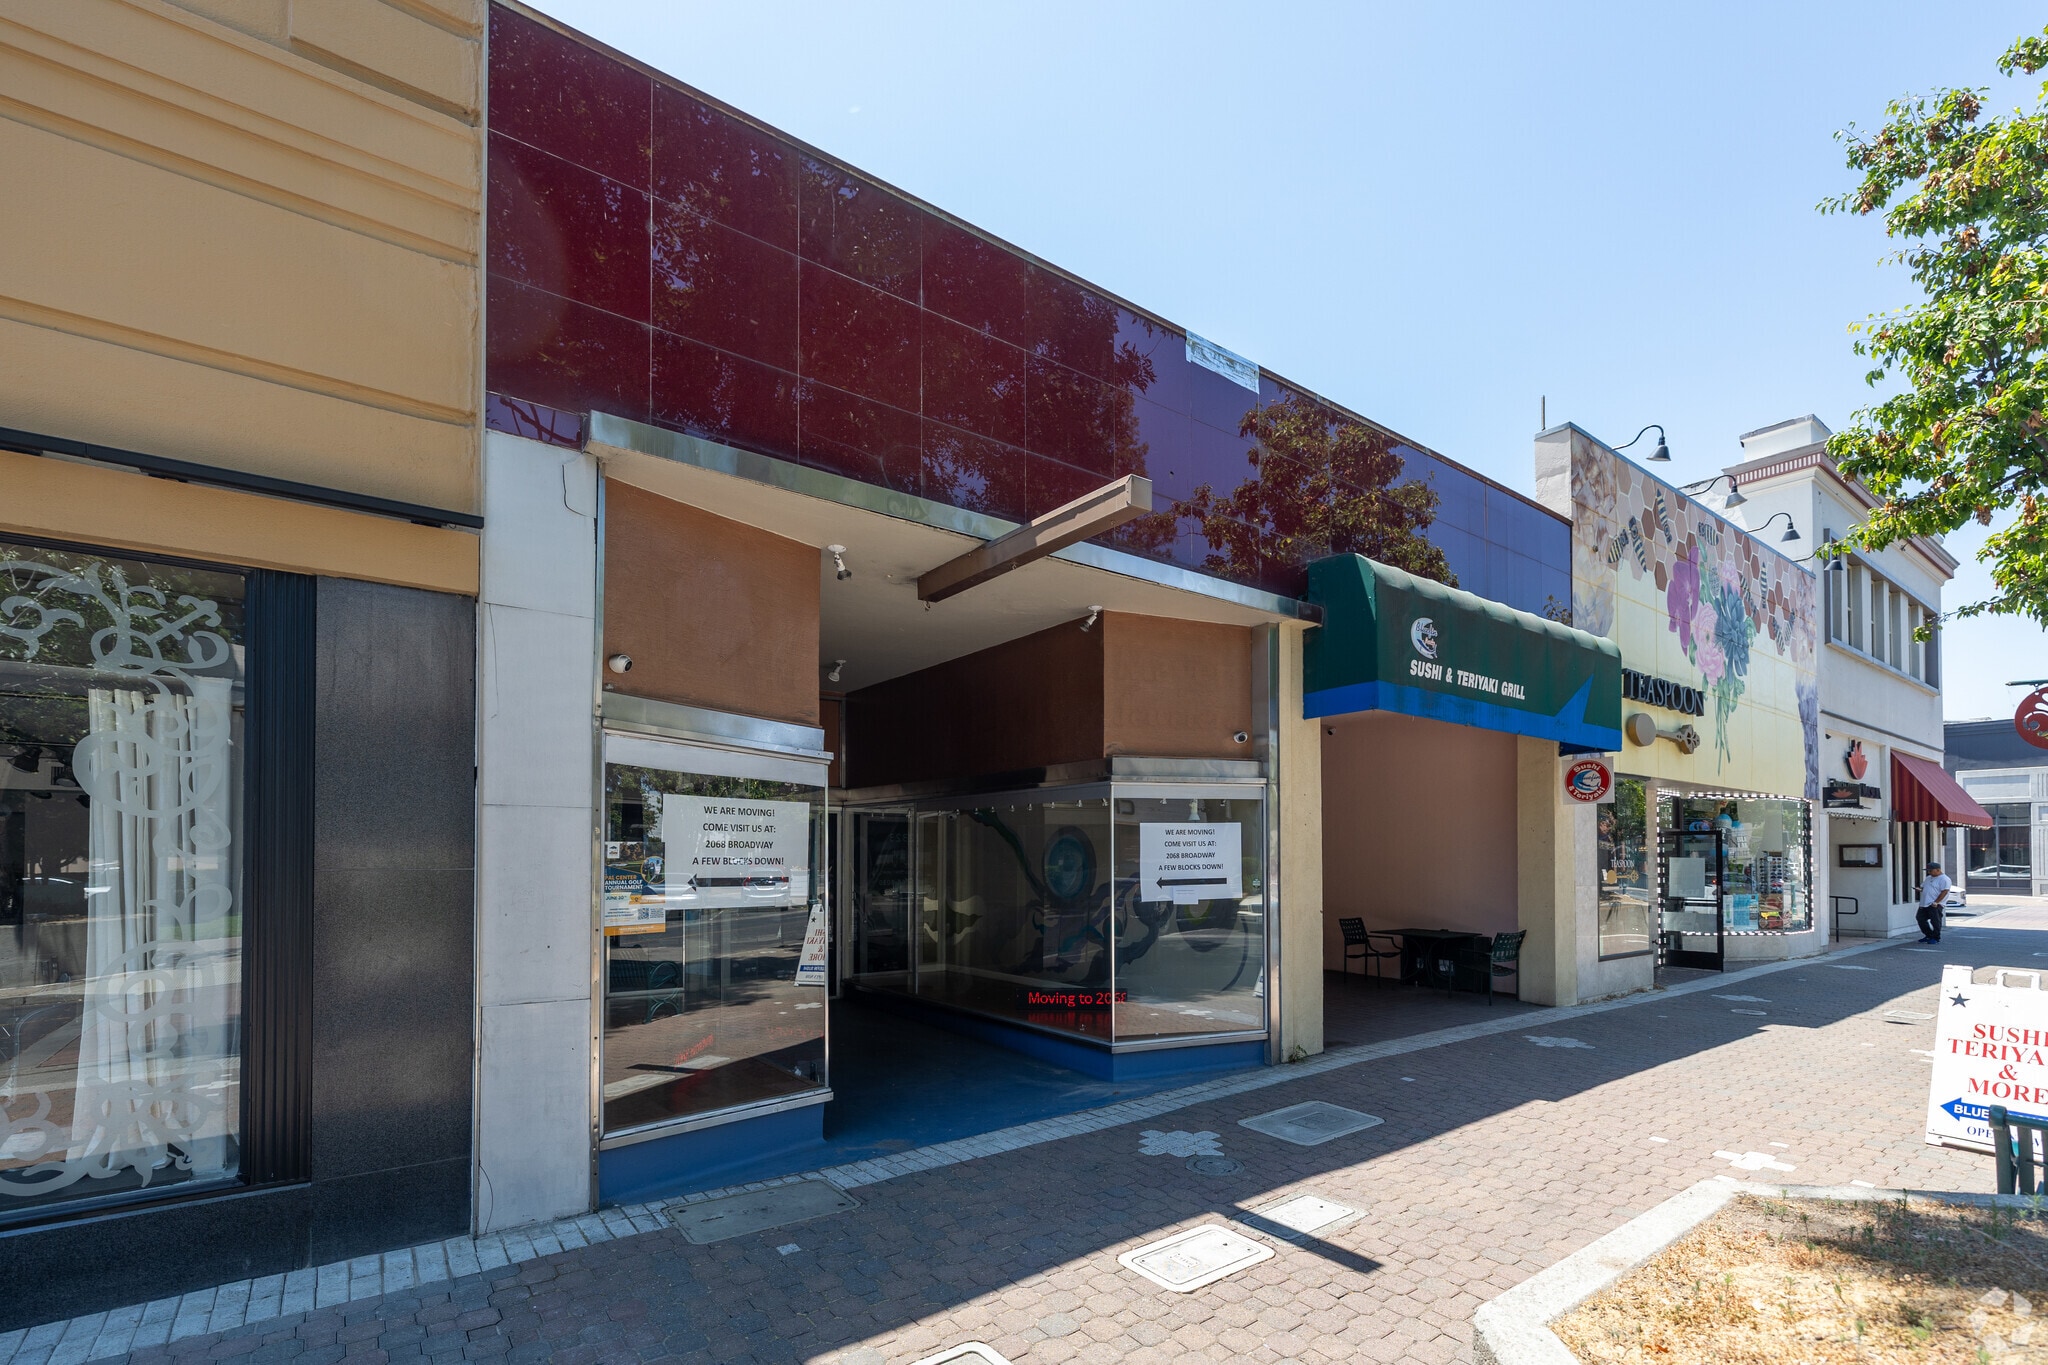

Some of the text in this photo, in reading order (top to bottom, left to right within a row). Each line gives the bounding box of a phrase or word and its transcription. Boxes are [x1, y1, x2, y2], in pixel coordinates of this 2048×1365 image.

[1410, 660, 1525, 700] SUSHI & TERIYAKI GRILL
[1622, 668, 1704, 717] TEASPOON
[1573, 763, 1601, 773] Sushi
[1573, 786, 1606, 801] Teriyaki
[704, 806, 775, 817] WE ARE MOVING!
[703, 823, 777, 833] COME VISIT US AT:
[705, 840, 774, 849] 2068 BROADWAY
[692, 857, 784, 866] A FEW BLOCKS DOWN!
[1610, 859, 1635, 868] TEASPOON
[1028, 992, 1077, 1007] Moving
[1079, 993, 1093, 1005] to
[1947, 1038, 2048, 1066] TERIYA
[1998, 1064, 2018, 1081] &
[1968, 1077, 2048, 1105] MORE
[1966, 1126, 1994, 1139] OPE
